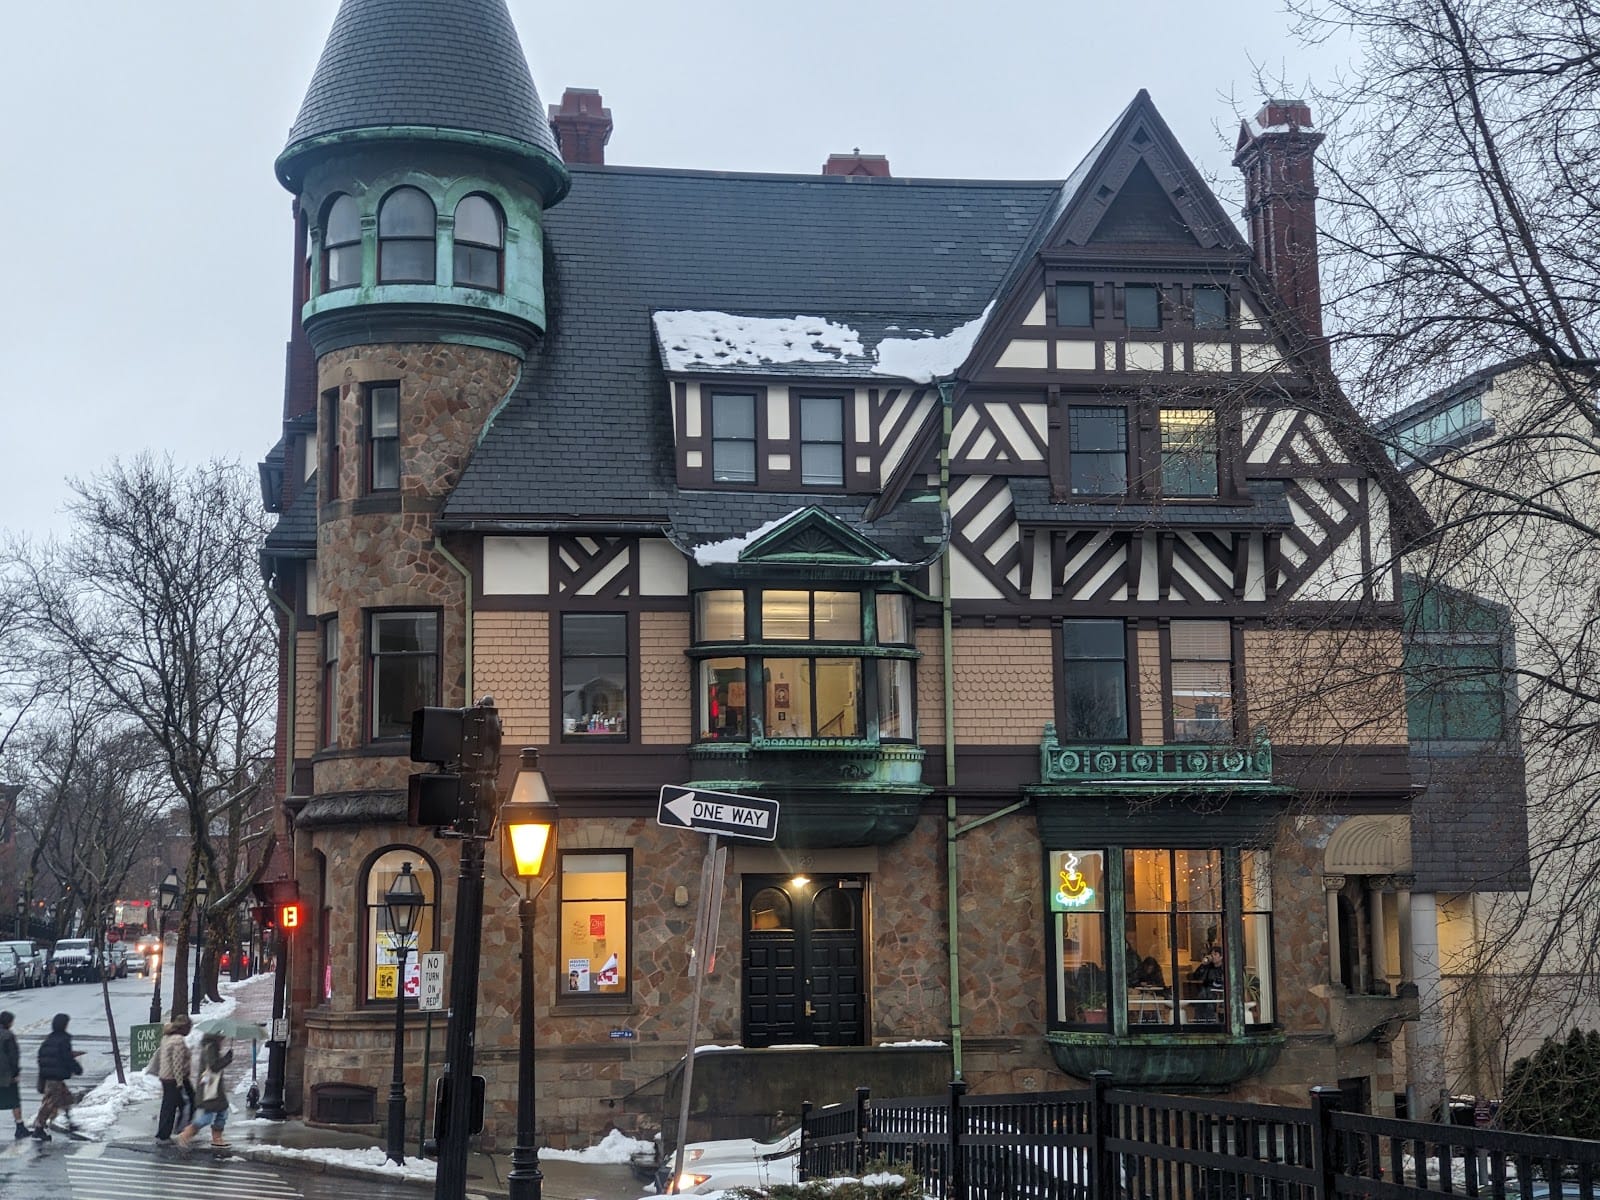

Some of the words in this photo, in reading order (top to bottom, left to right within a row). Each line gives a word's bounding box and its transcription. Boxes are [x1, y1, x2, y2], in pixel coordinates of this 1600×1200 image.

[693, 802, 724, 820] ONE
[732, 808, 764, 825] WAY
[283, 906, 298, 927] 13
[427, 957, 439, 969] NO
[425, 971, 440, 982] TURN
[427, 984, 436, 994] ON
[426, 996, 437, 1006] RED
[137, 1040, 157, 1052] HAUS
